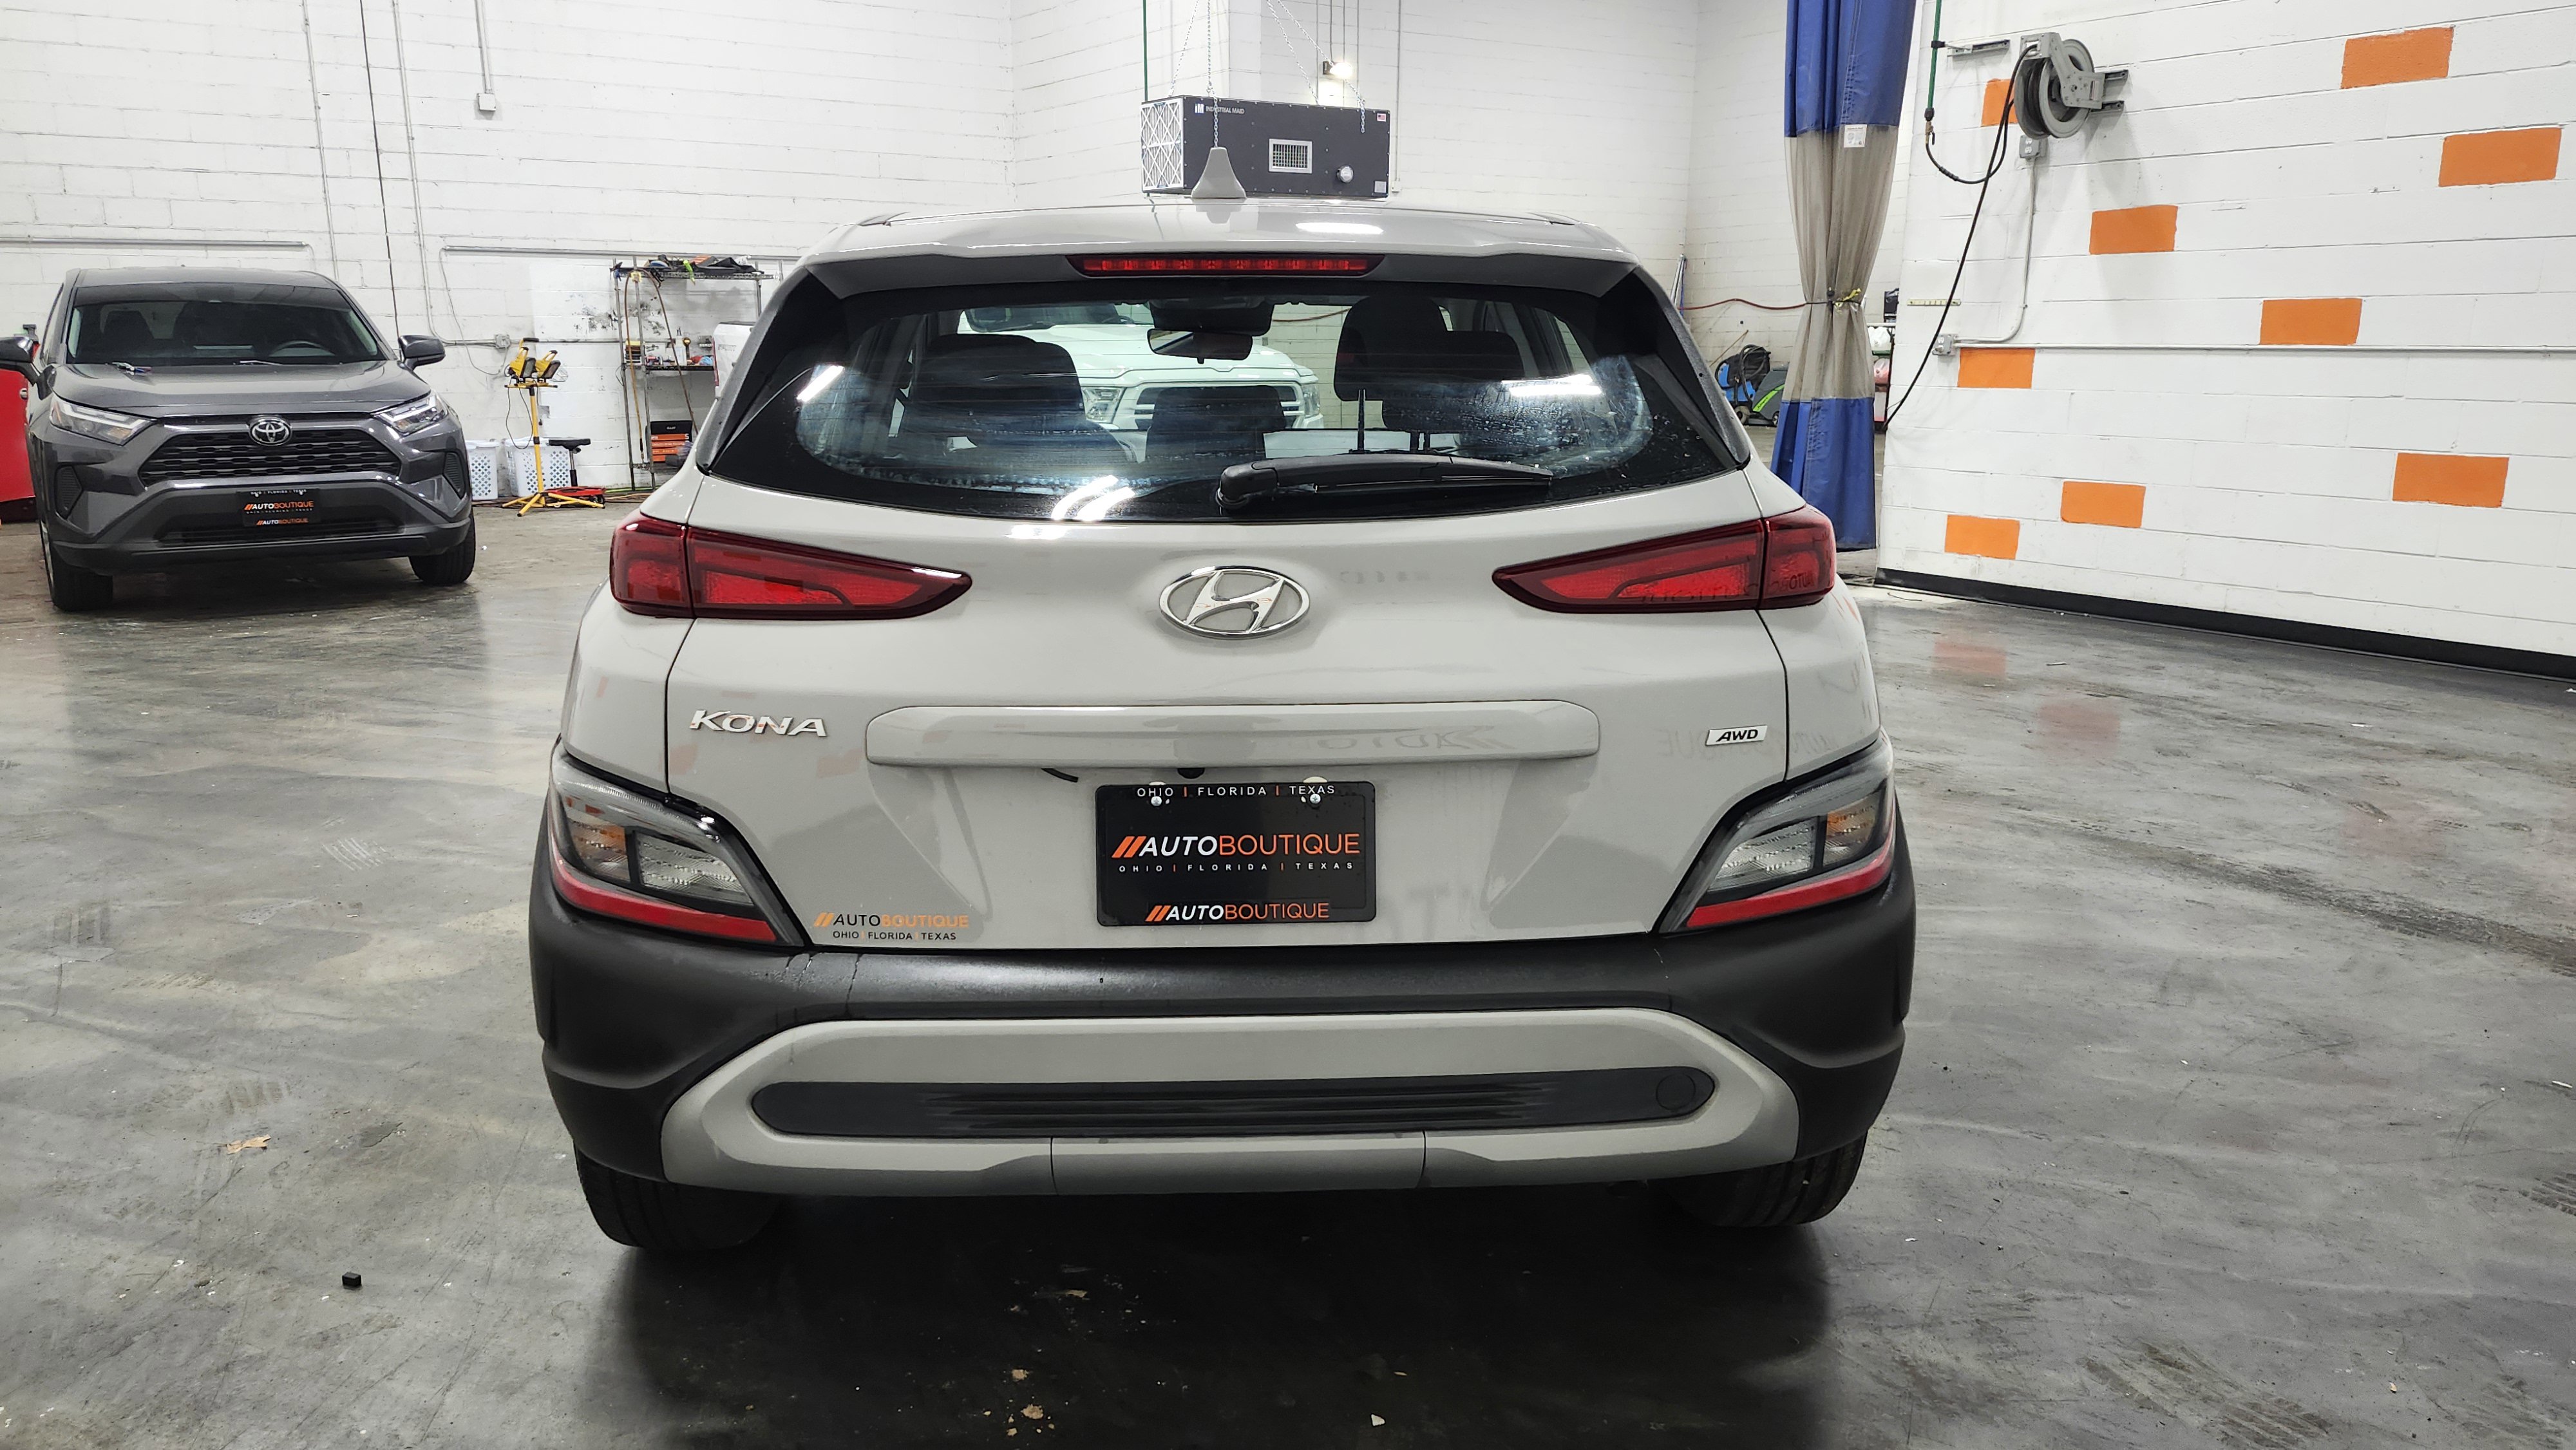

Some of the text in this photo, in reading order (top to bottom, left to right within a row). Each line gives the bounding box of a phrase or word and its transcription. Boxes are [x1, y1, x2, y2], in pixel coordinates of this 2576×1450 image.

[251, 501, 314, 510] AUTOBOUTIQUE
[689, 709, 828, 737] KONA
[1716, 729, 1759, 742] AWD
[1137, 785, 1336, 797] OHIO FLORIDA TEXAS
[1138, 833, 1361, 858] AUTOBOUTIQUE
[1119, 862, 1353, 873] OHIO FLORIDA TEXAS
[1165, 903, 1331, 921] AUTOBOUTIQUE
[833, 914, 969, 928] AUTOBOUTIQUE
[832, 930, 957, 941] OHIO FLORIDA TEXAS
